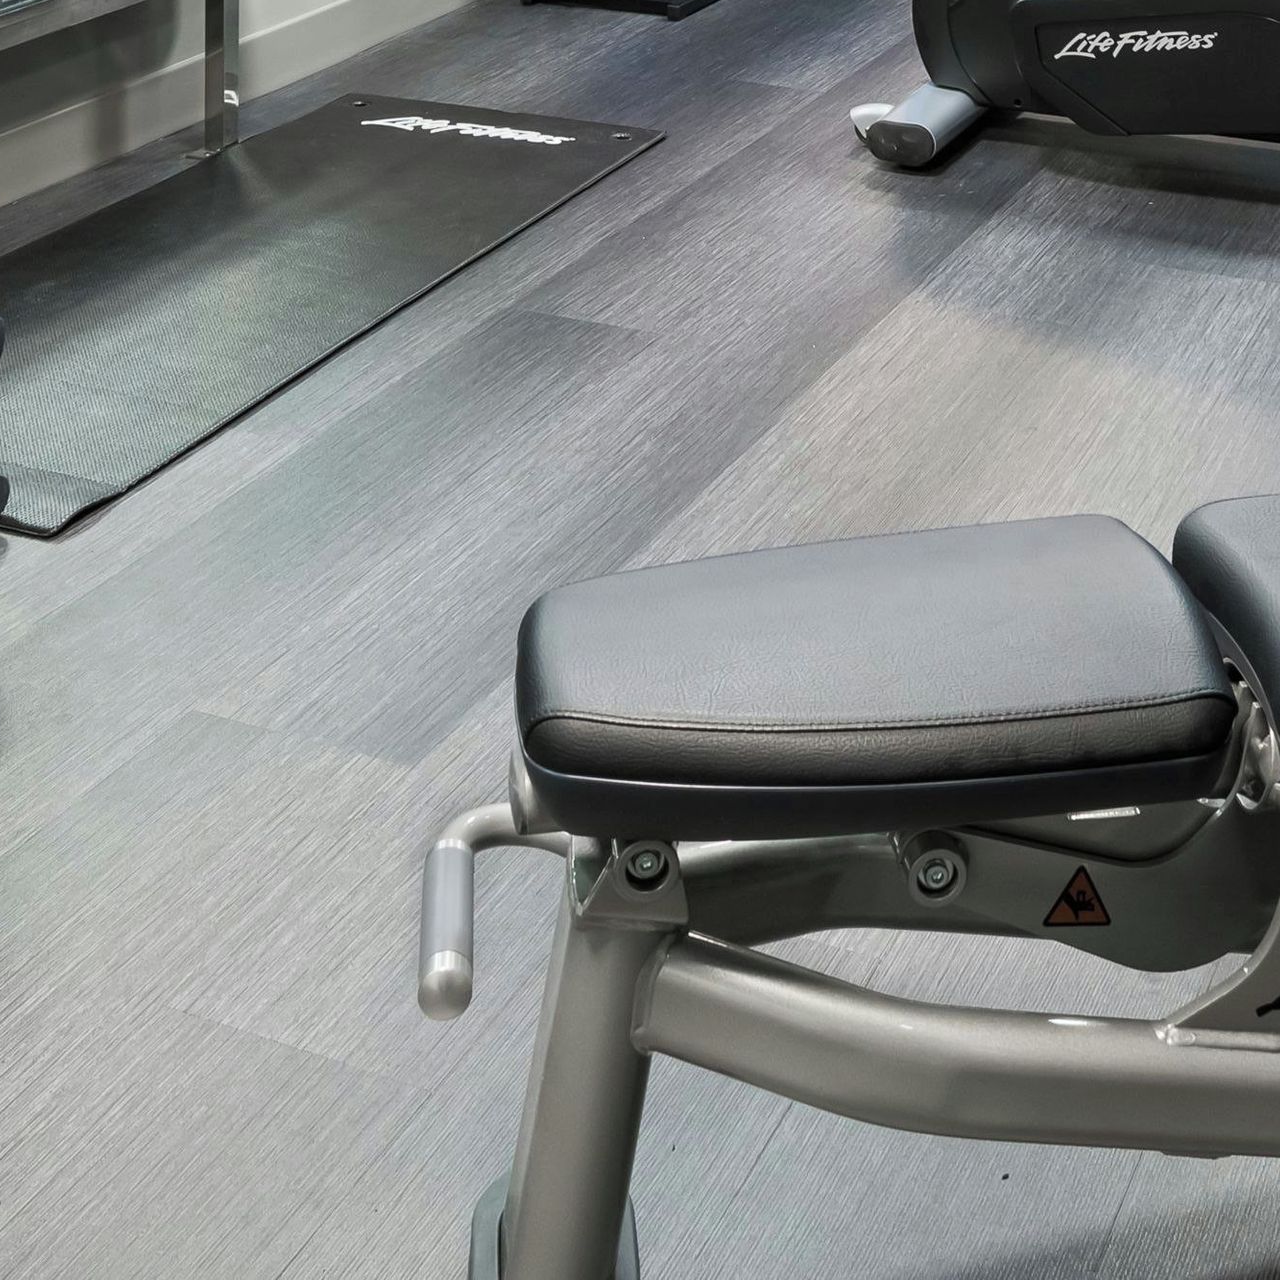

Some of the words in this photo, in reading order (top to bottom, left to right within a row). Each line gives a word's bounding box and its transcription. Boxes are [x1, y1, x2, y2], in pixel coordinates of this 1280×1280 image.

[1053, 31, 1115, 60] Life
[1112, 30, 1218, 59] Fitness
[361, 116, 450, 131] Life
